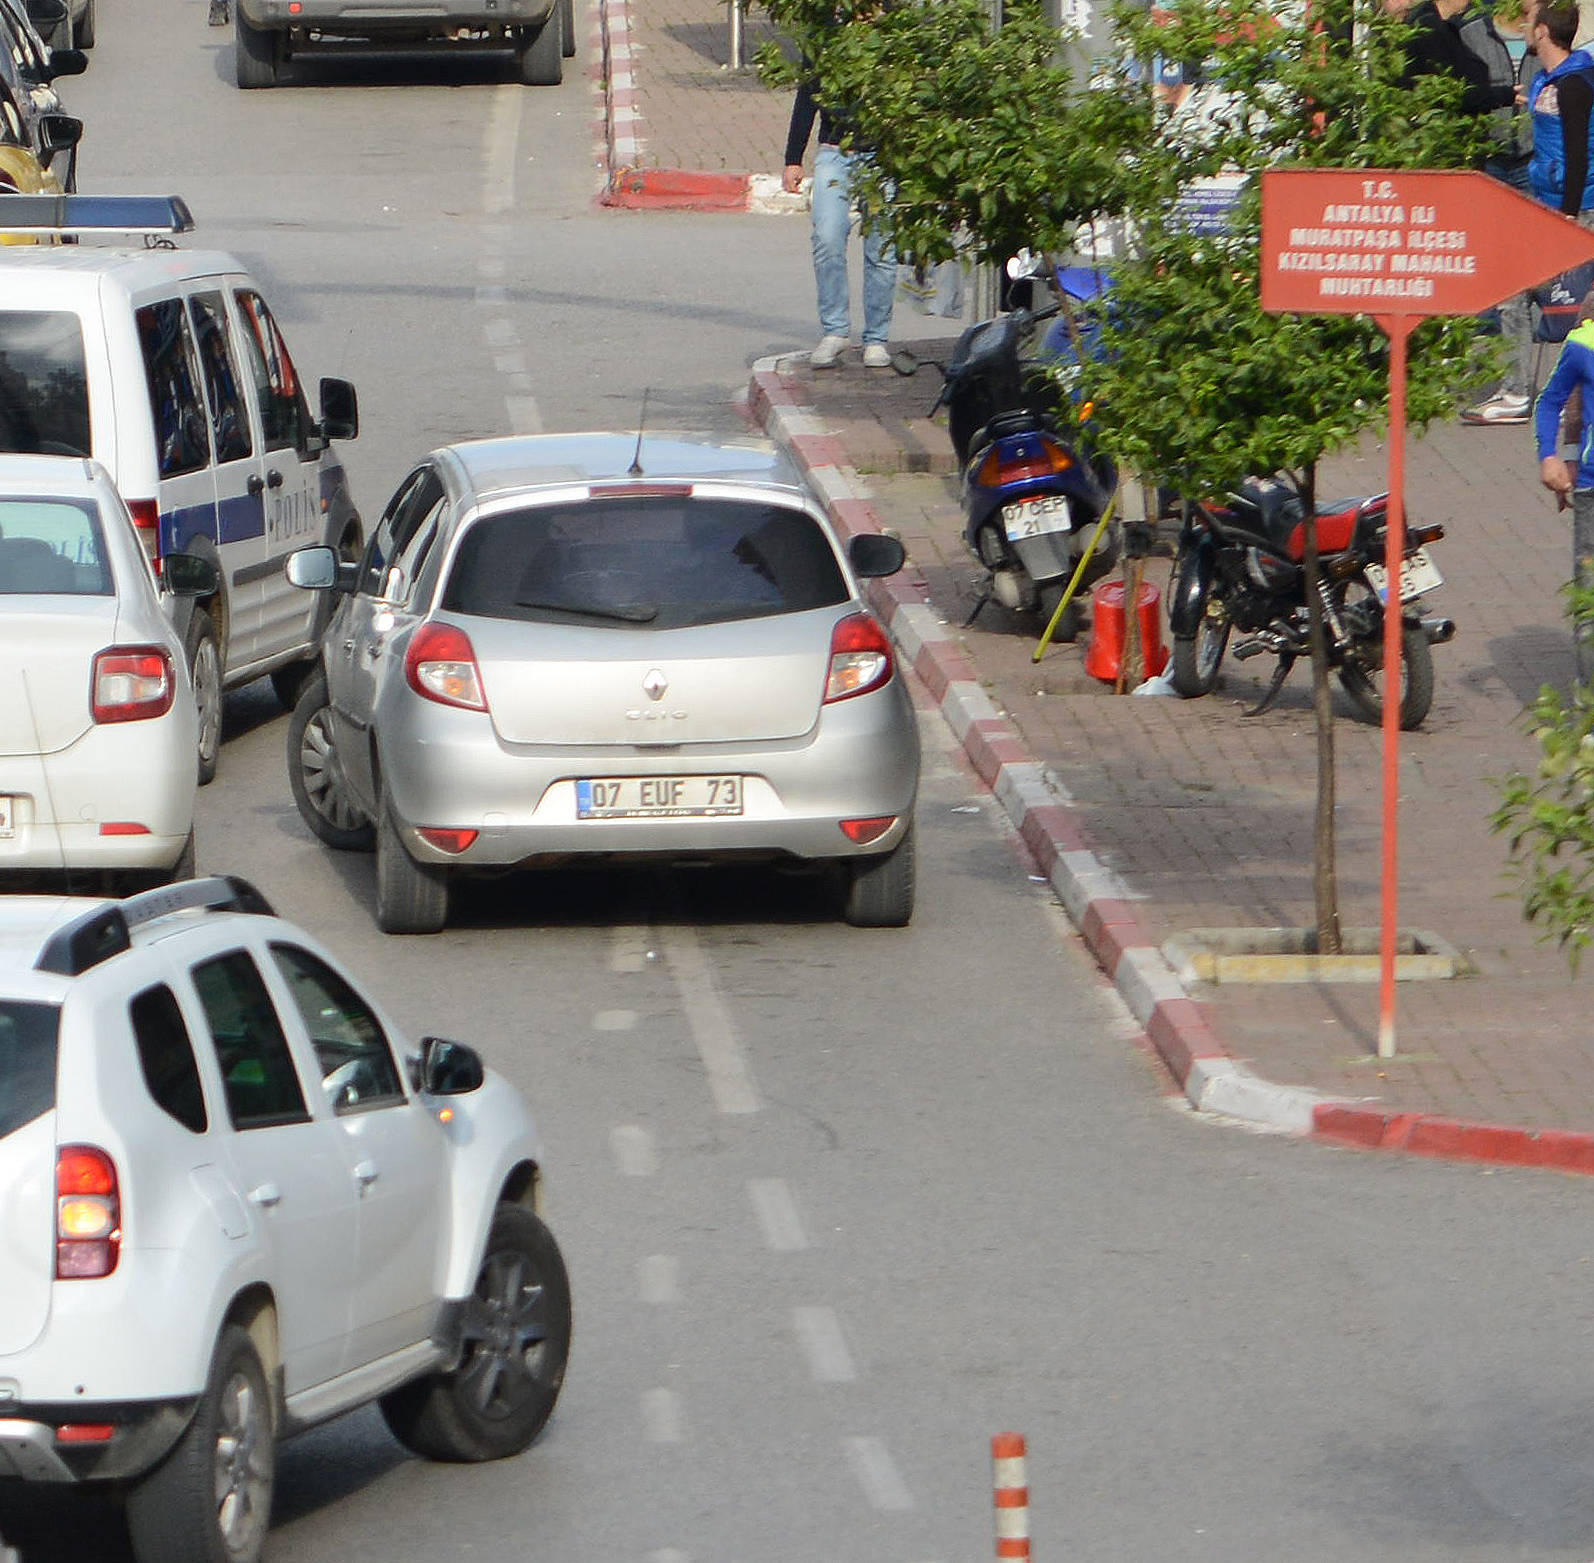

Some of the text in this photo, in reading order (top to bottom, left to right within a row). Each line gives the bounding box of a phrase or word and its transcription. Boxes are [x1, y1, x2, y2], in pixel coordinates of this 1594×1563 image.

[1361, 180, 1399, 199] T.C.
[1322, 204, 1406, 224] ANTALYA
[1288, 227, 1402, 250] MURATPAŞA
[1277, 252, 1477, 274] KIZILSARAY MAHALLE
[1319, 276, 1435, 298] MUHTARLIĞI
[1004, 503, 1024, 521] 07
[592, 779, 736, 808] 07 EUF 73
